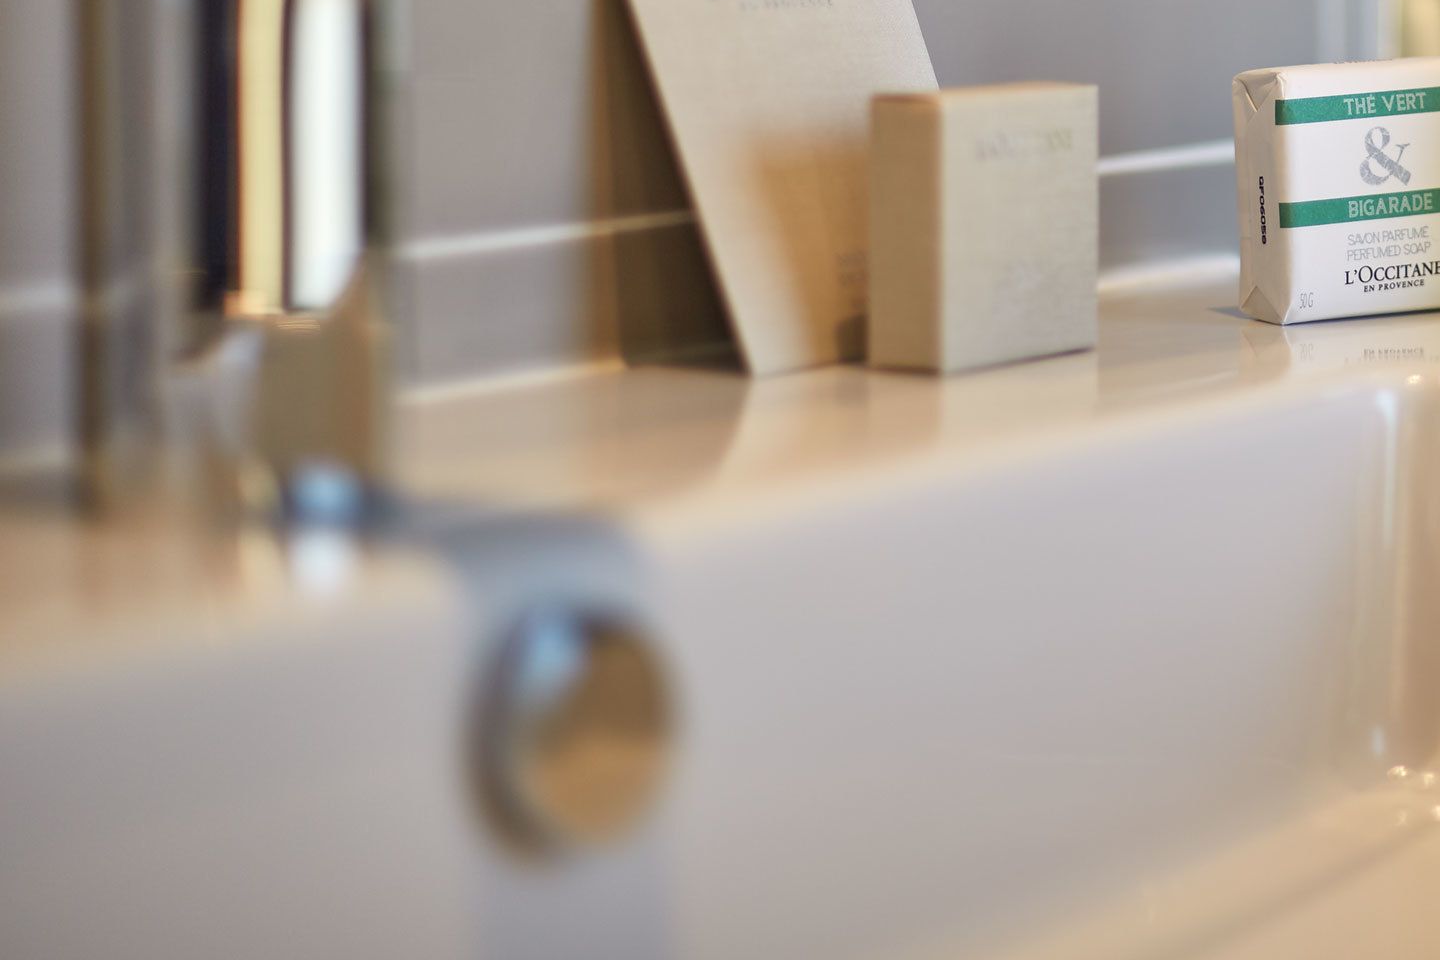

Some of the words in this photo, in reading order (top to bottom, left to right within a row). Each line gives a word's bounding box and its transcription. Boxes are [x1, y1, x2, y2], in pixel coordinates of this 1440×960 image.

[1343, 94, 1377, 116] THÉ
[1381, 91, 1427, 112] VERT
[1360, 126, 1411, 186] &
[1348, 192, 1433, 218] BIGARADE
[1348, 231, 1380, 246] SAVON
[1346, 244, 1401, 261] PERFUMED
[1403, 241, 1431, 255] SOAP
[1363, 284, 1375, 293] EN
[1378, 279, 1425, 291] PROVENCE
